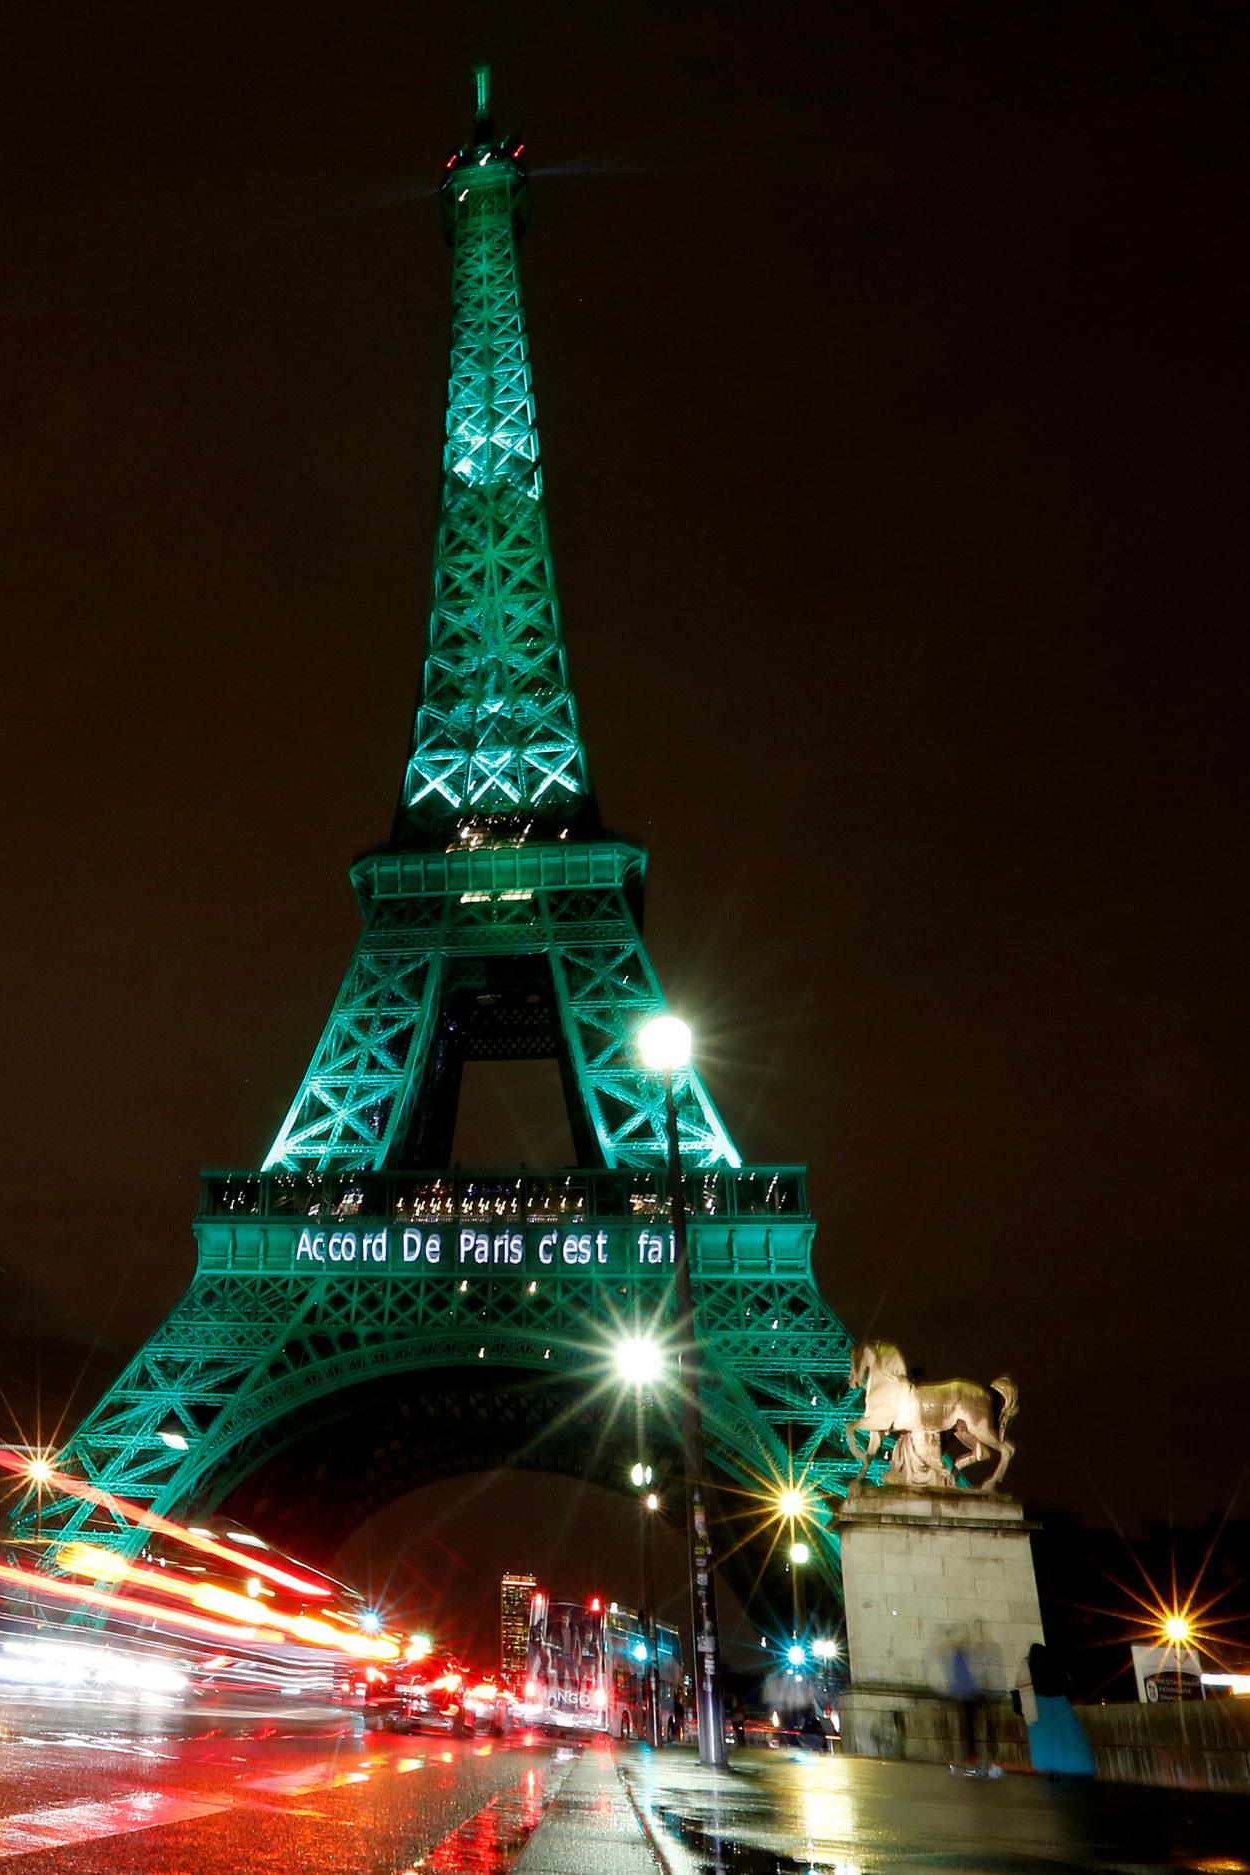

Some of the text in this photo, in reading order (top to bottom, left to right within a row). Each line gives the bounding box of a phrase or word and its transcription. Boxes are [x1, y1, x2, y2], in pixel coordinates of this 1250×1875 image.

[296, 1228, 676, 1264] Accord De Paris c'est fai
